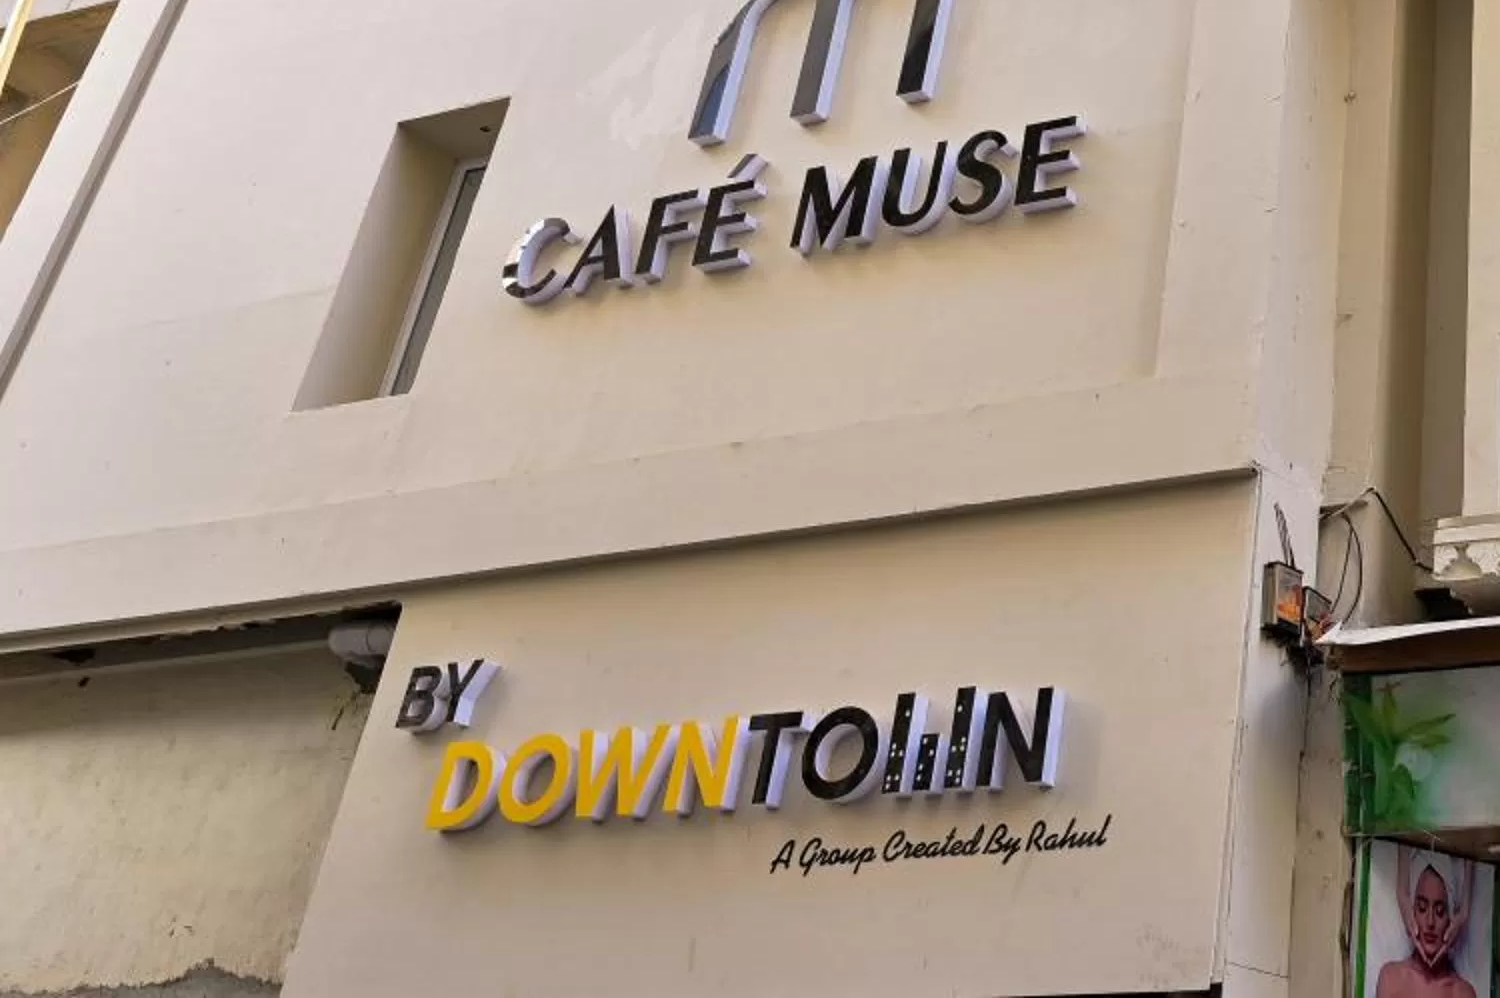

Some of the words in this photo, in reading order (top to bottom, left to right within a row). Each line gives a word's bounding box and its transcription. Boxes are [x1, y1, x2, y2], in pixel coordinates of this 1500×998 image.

[501, 153, 767, 303] CAFÉ
[790, 115, 1088, 257] MUSE
[396, 659, 500, 733] BY
[770, 839, 797, 874] A
[799, 837, 877, 877] Group
[882, 822, 985, 863] Created
[982, 823, 1021, 865] By
[1024, 814, 1113, 853] Rahul
